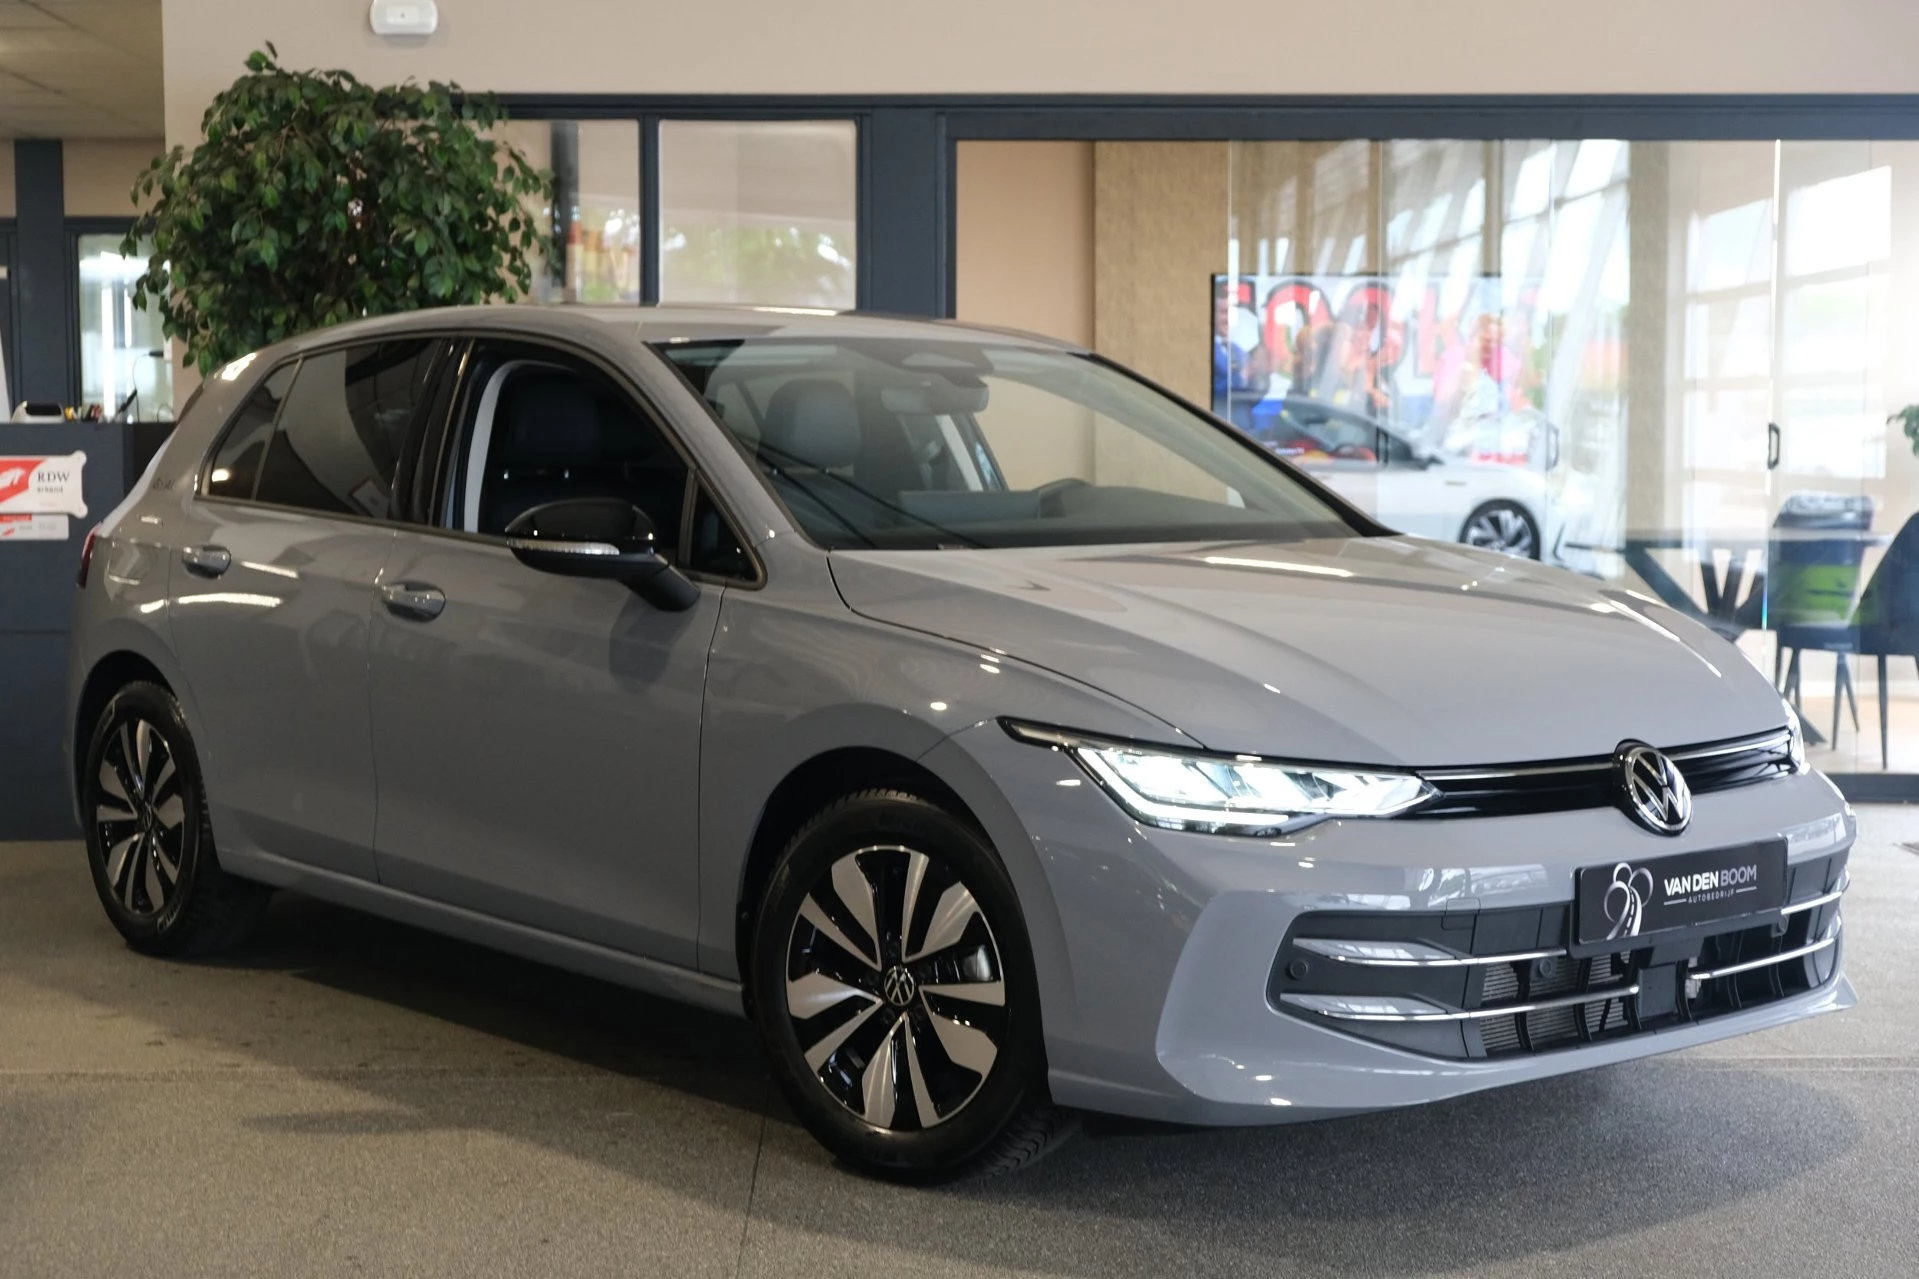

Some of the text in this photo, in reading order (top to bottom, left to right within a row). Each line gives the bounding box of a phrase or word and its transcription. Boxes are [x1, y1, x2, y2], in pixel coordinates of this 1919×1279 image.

[37, 471, 70, 482] RDW
[1664, 864, 1757, 896] VAN DEN BOOM
[1687, 888, 1735, 904] AUTOBEDRIJF
